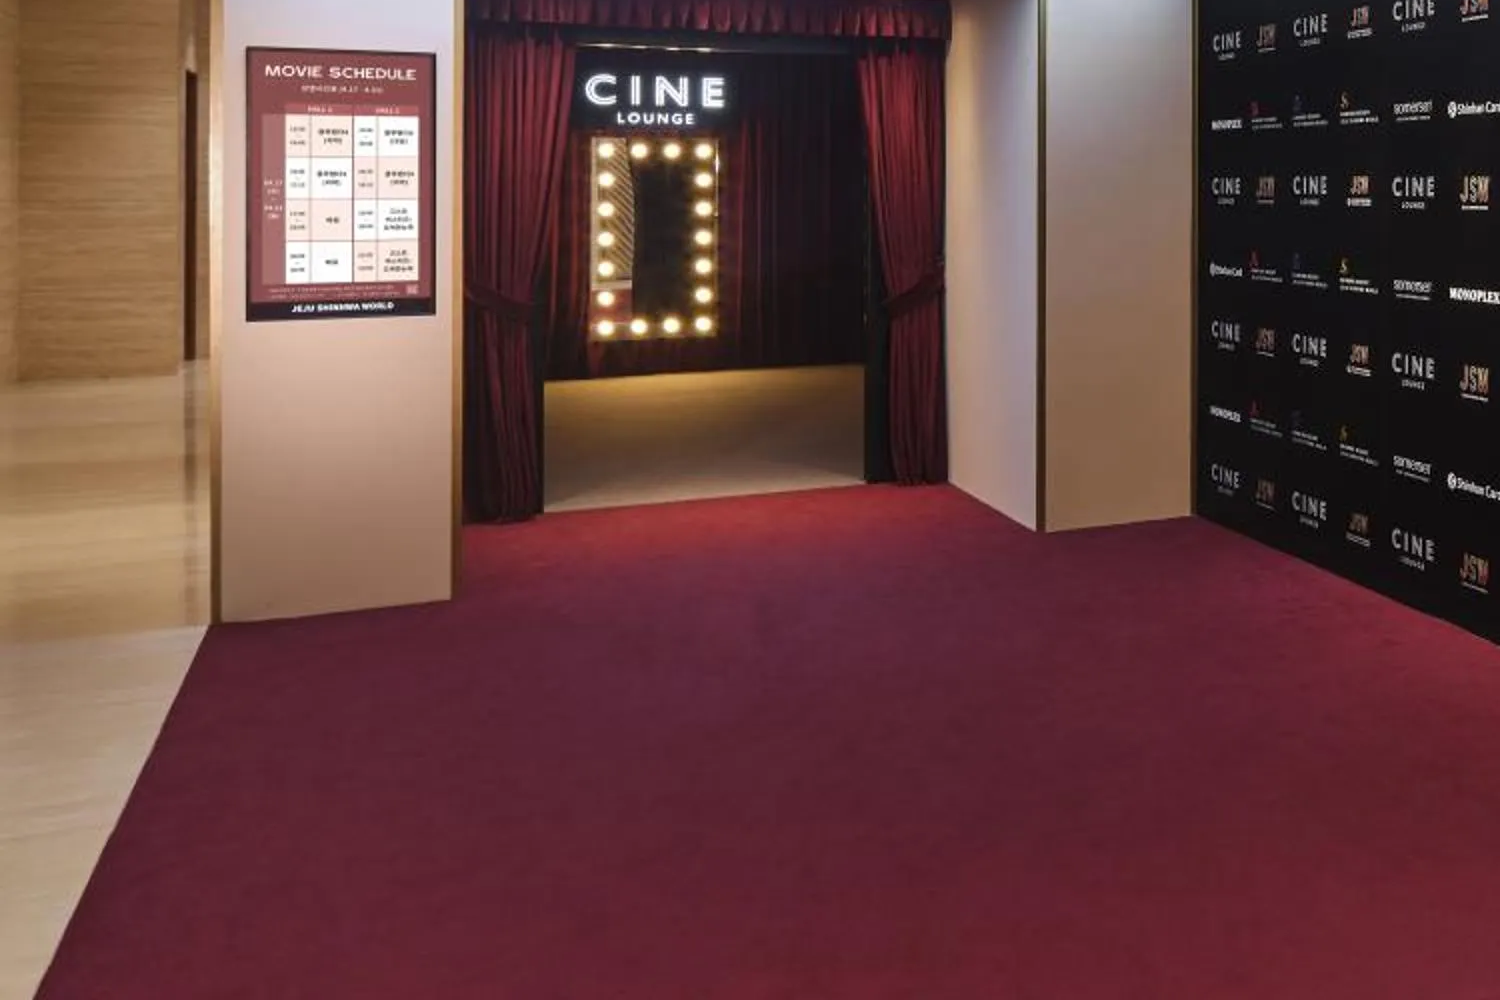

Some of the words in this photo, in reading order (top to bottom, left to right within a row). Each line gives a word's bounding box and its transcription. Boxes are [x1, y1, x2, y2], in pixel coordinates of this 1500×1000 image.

[1293, 13, 1327, 37] CINE
[265, 64, 323, 78] MOVIE
[329, 66, 417, 81] SCHEDULE
[585, 73, 725, 108] CINE
[617, 112, 695, 125] LOUNGE
[1293, 175, 1326, 194] CINE
[1391, 176, 1434, 197] CINE
[1449, 286, 1500, 305] MONOPLEX
[1292, 333, 1326, 358] CINE
[1391, 351, 1434, 379] CINE
[1292, 489, 1326, 521] CINE
[1391, 526, 1434, 562] CINE
